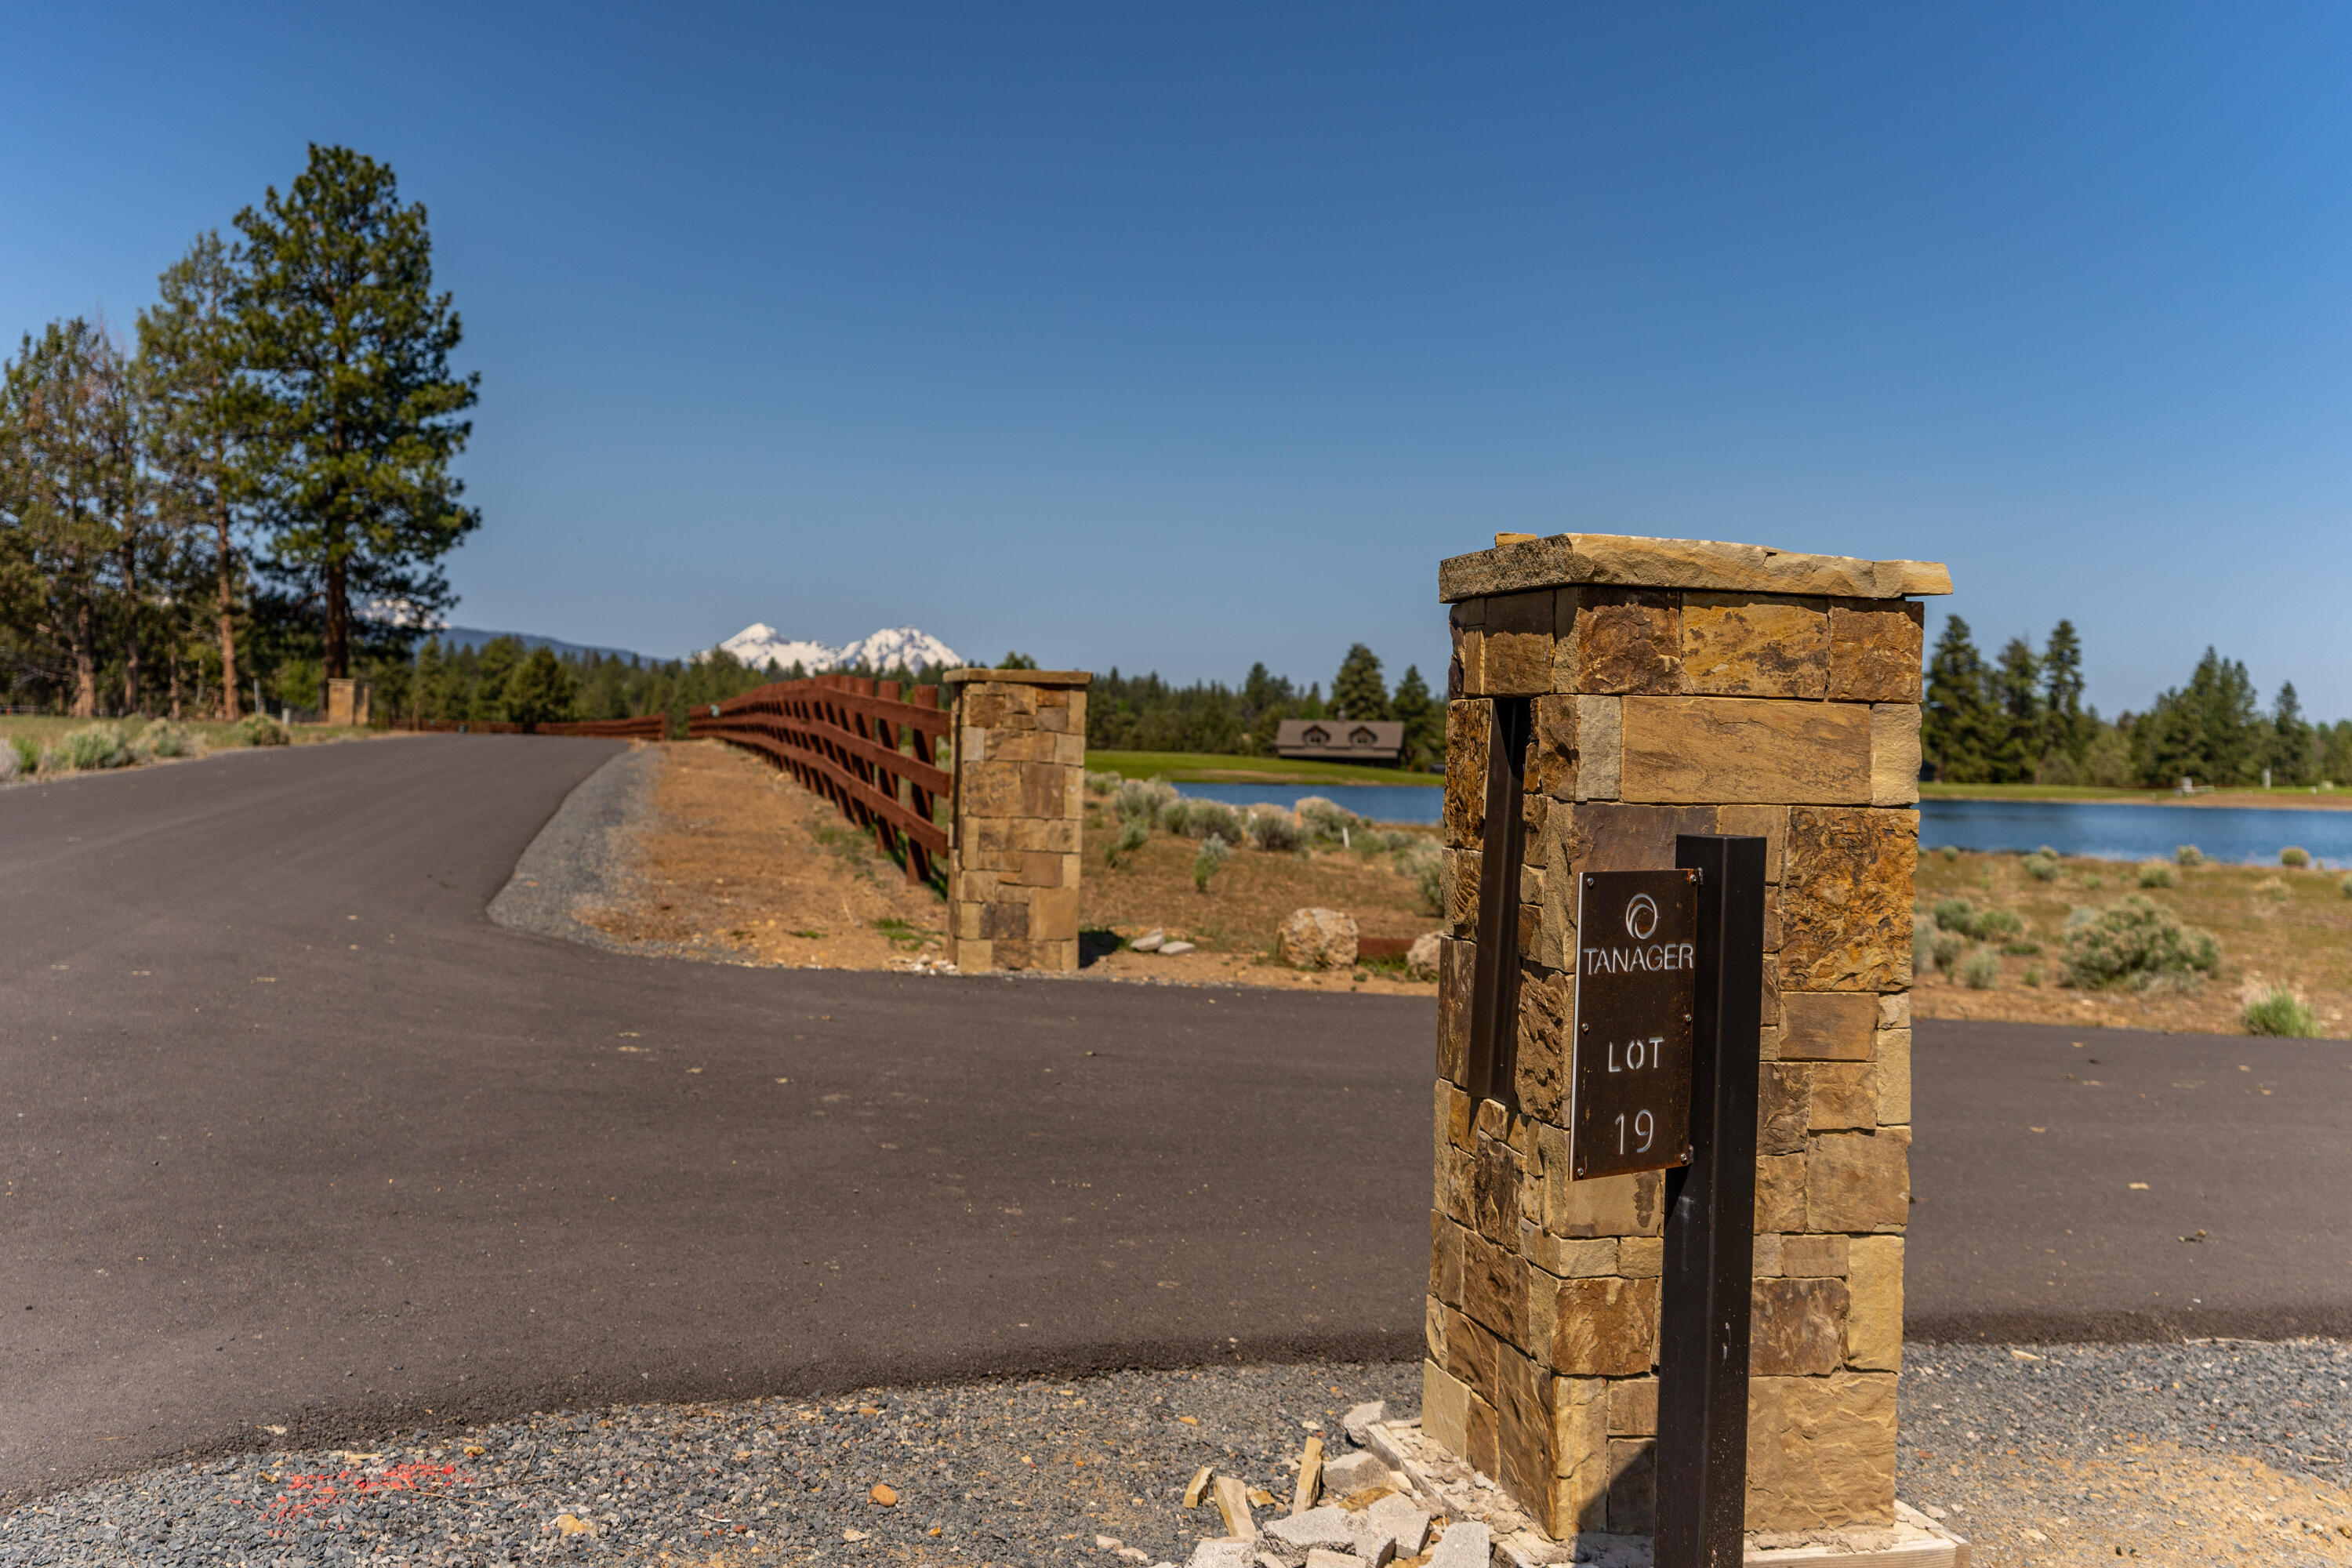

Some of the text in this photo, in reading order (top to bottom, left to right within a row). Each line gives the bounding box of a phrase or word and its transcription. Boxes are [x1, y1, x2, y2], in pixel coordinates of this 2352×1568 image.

[1583, 942, 1694, 976] TANAGER
[1607, 1036, 1665, 1073] LOT
[1614, 1109, 1654, 1155] 19
